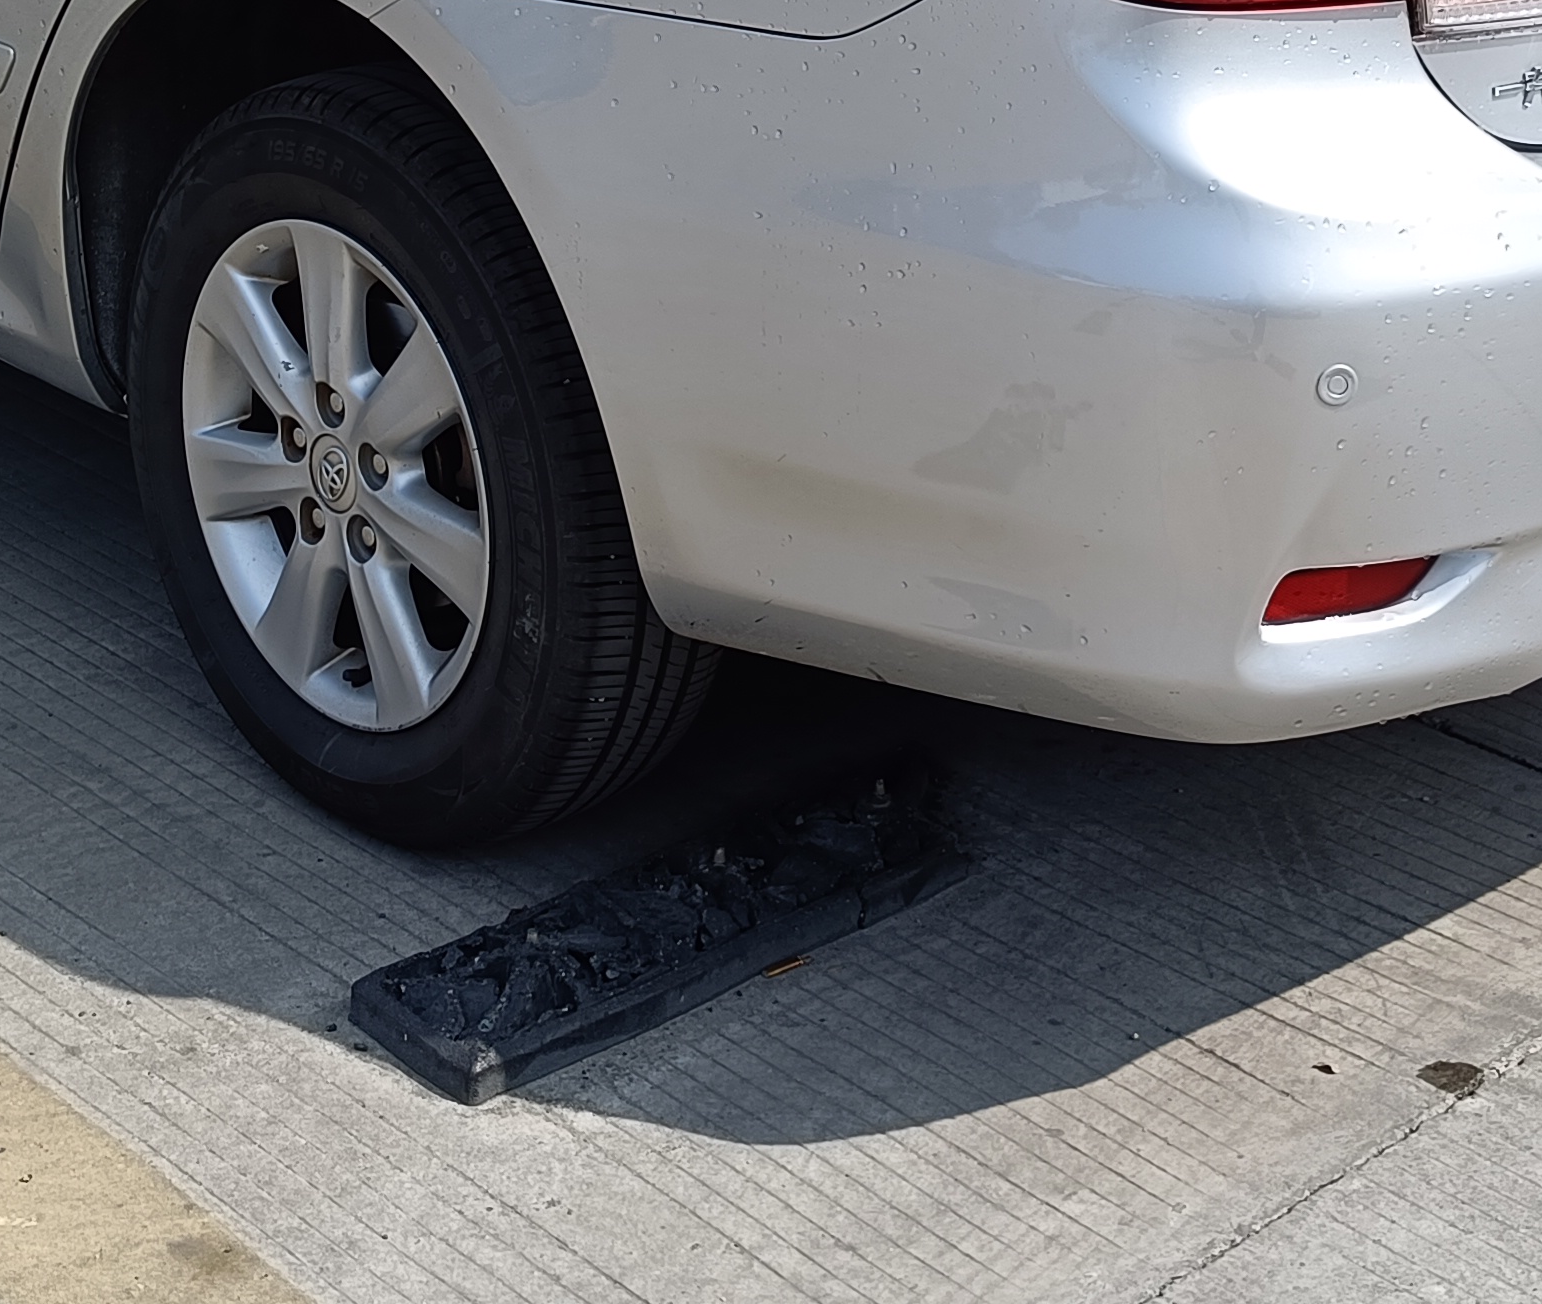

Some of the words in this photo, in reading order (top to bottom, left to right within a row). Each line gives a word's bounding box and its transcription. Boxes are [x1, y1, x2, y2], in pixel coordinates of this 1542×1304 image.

[267, 139, 328, 170] 195/65
[330, 155, 345, 178] R
[347, 166, 369, 192] 15
